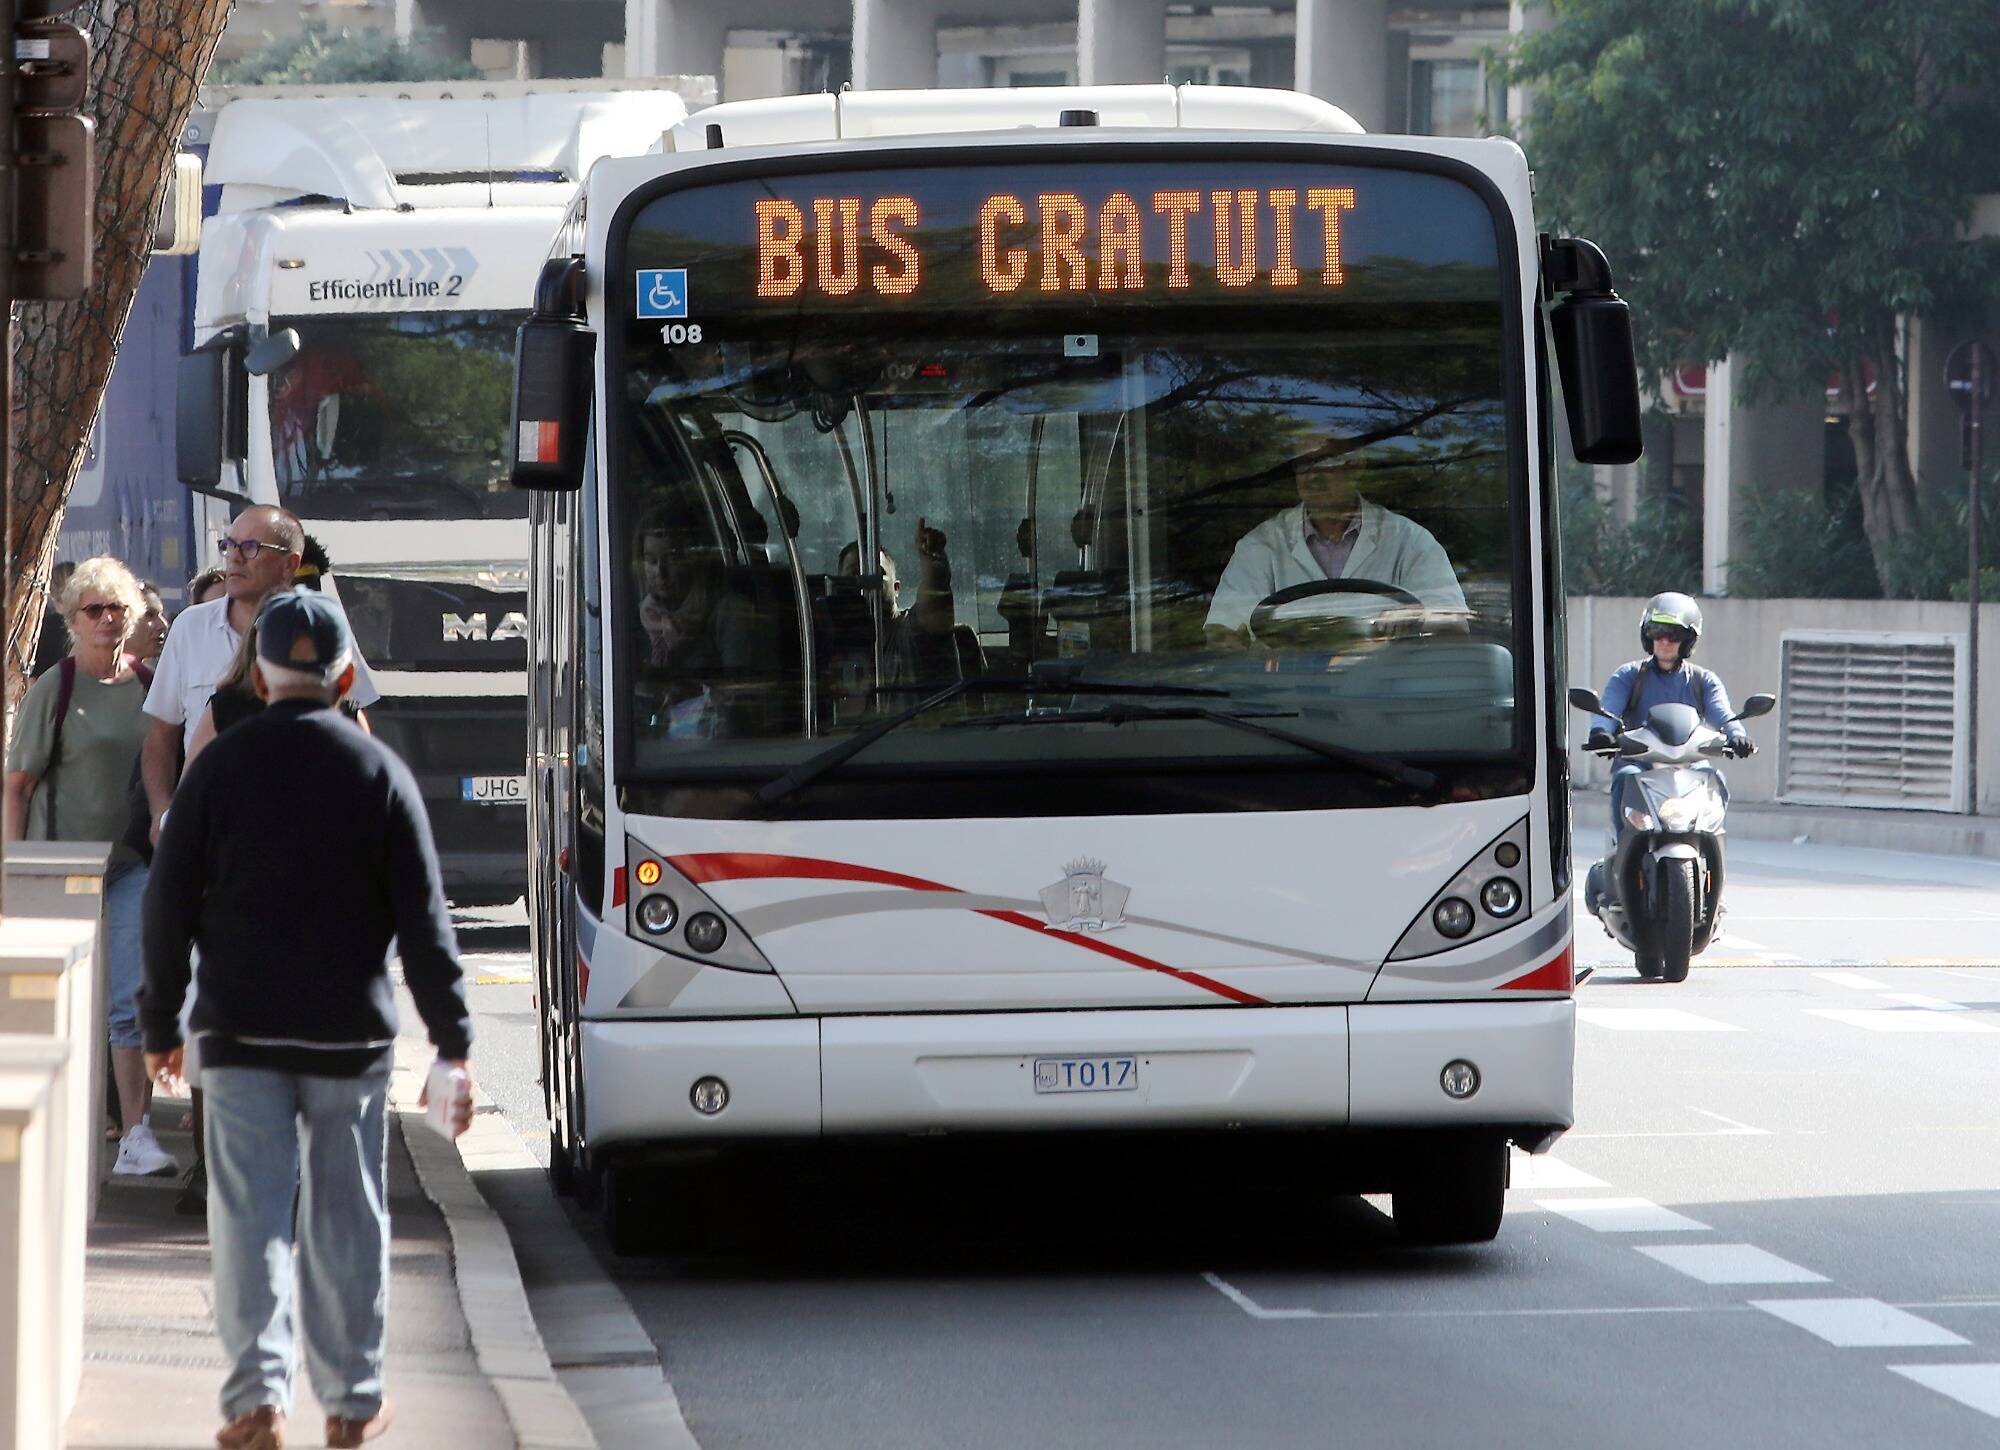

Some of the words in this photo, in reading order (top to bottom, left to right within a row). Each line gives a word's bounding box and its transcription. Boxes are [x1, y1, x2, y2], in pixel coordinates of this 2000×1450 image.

[755, 196, 920, 297] BUS
[979, 187, 1356, 293] GRATUIT
[309, 277, 440, 301] EfficientLine
[446, 275, 463, 297] 2
[660, 323, 703, 345] 108
[476, 778, 519, 798] JHG
[1061, 1060, 1132, 1088] T017
